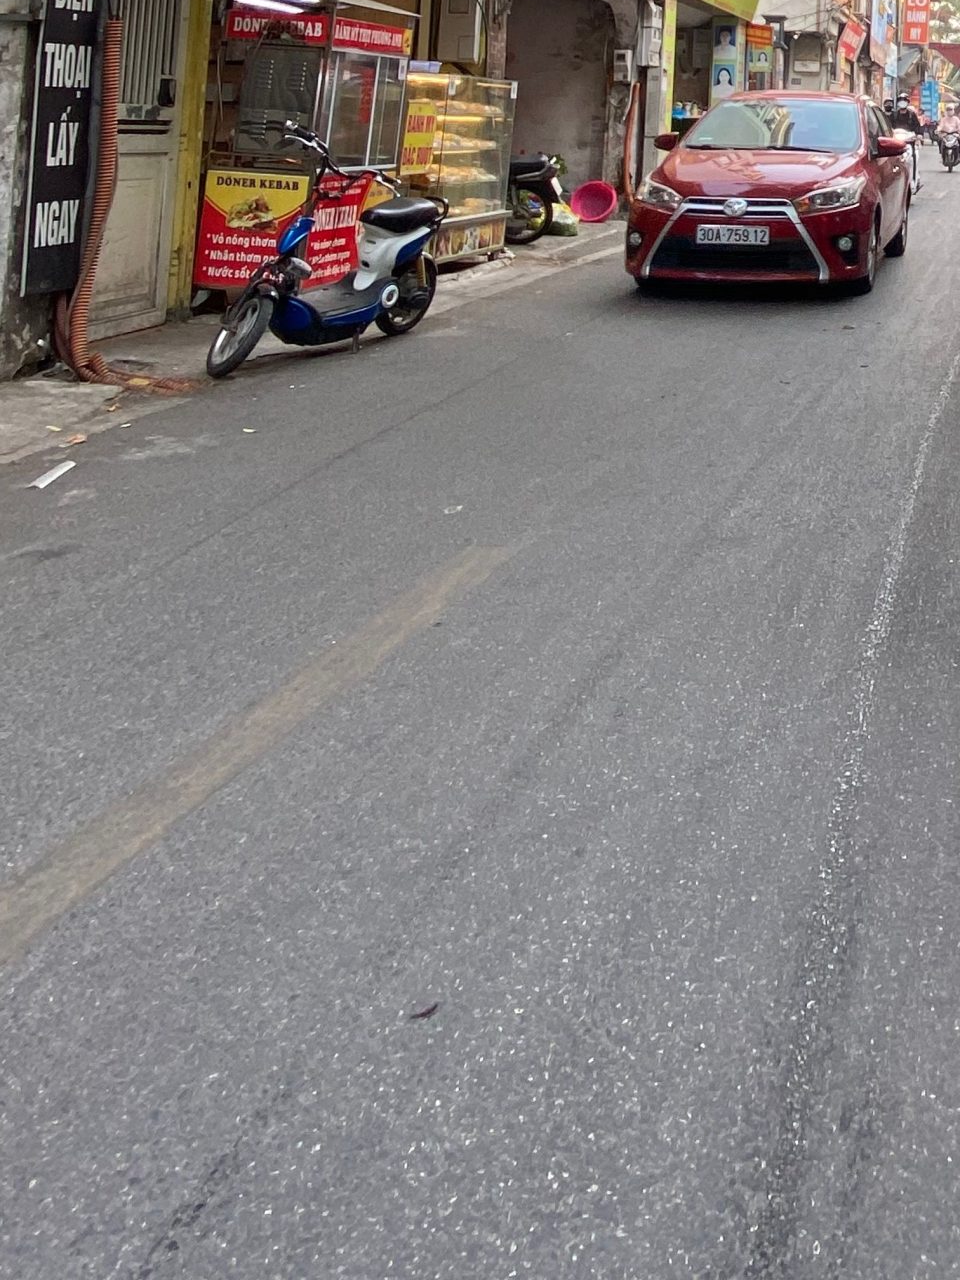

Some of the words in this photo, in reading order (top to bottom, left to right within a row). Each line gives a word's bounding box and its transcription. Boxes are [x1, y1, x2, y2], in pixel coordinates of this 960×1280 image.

[44, 42, 92, 98] THOẠI
[46, 106, 79, 167] LẤY
[259, 179, 299, 191] KEBAB
[34, 199, 80, 249] NGAY
[225, 234, 249, 248] nóng
[251, 236, 277, 248] thơm
[209, 250, 236, 262] Nhân
[236, 252, 261, 263] thơm
[207, 266, 233, 278] Nước
